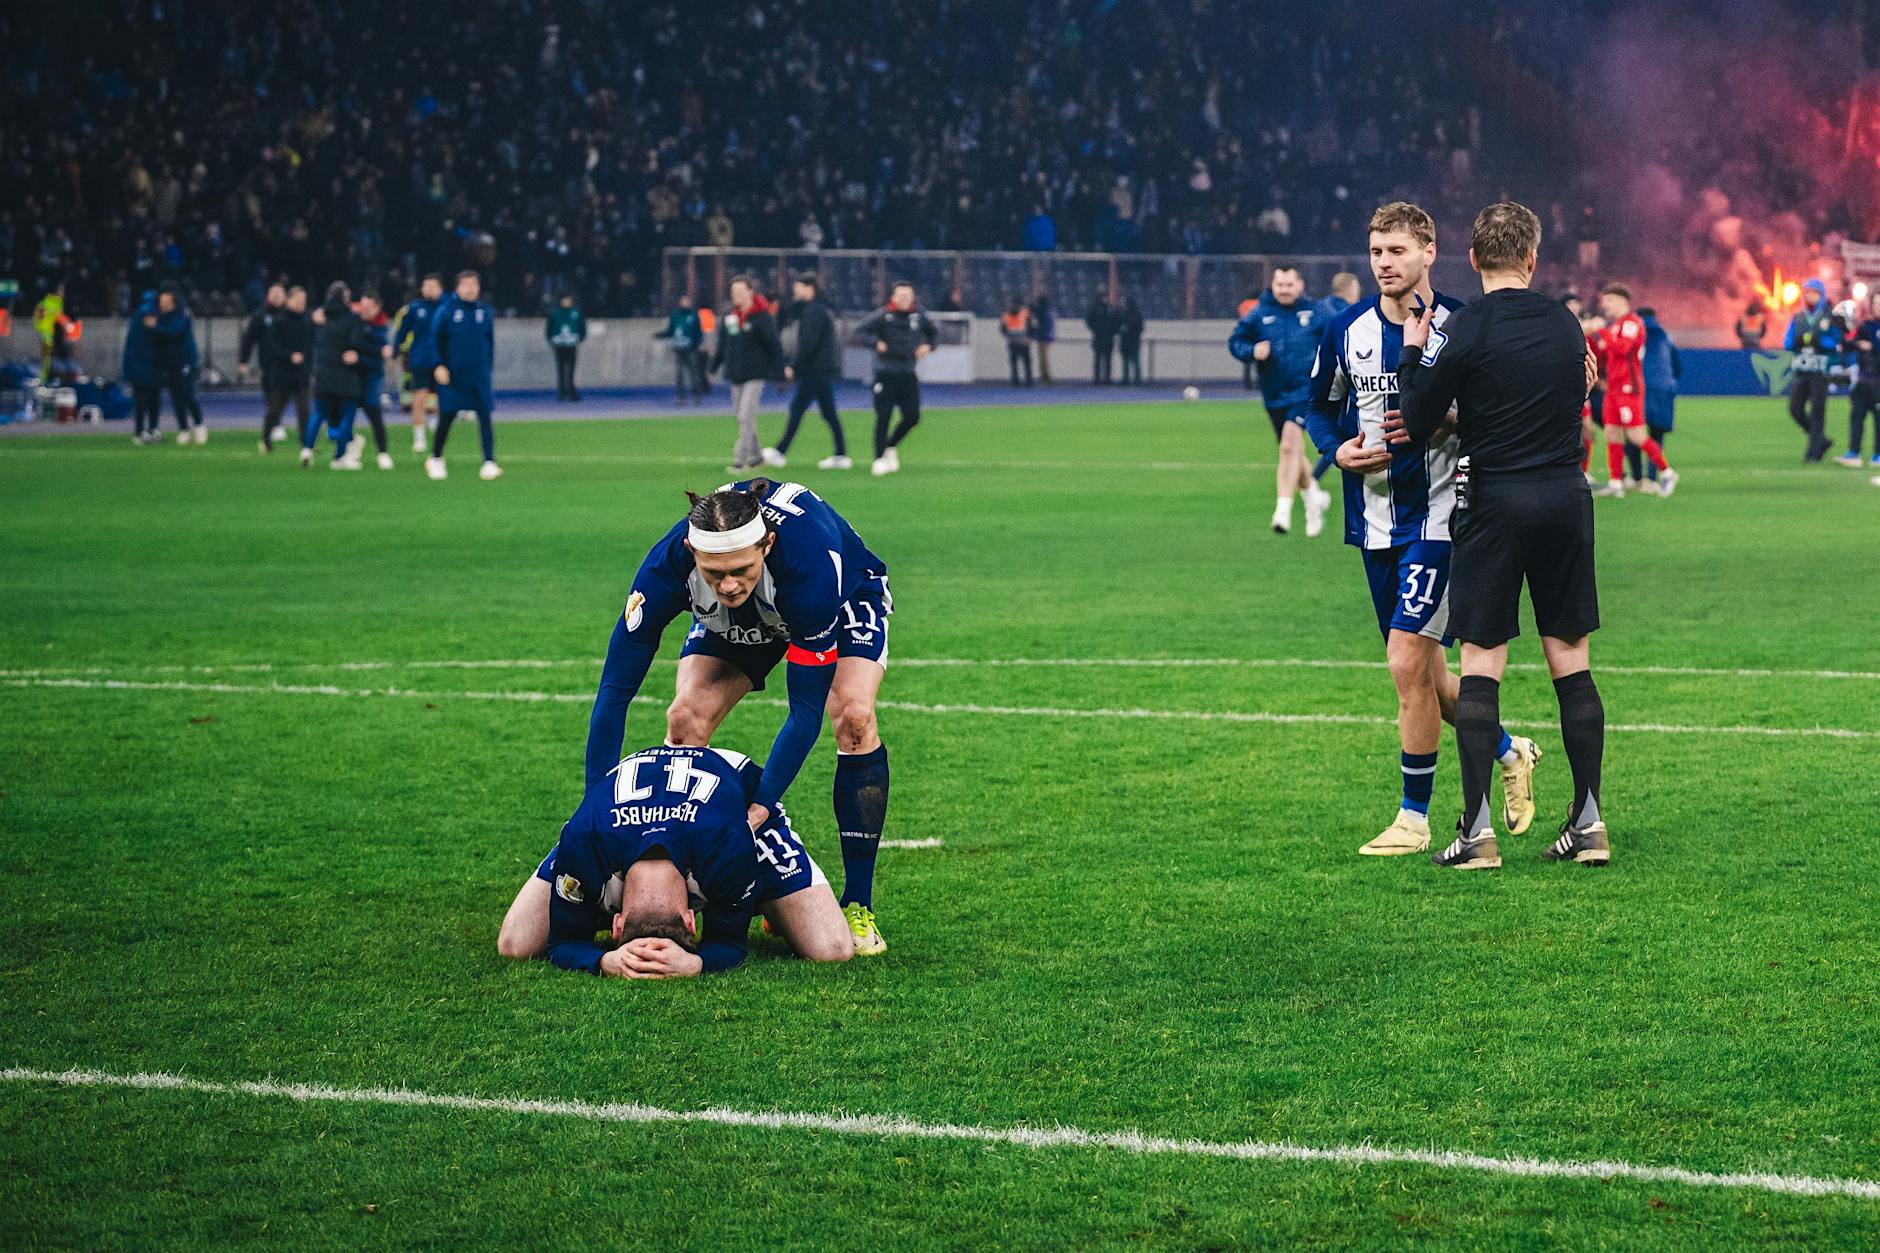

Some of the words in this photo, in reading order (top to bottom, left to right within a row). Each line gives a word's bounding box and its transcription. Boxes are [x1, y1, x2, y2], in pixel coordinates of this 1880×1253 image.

[1401, 563, 1438, 605] 31
[839, 599, 881, 633] 11
[605, 755, 721, 805] 41
[756, 828, 801, 865] 41
